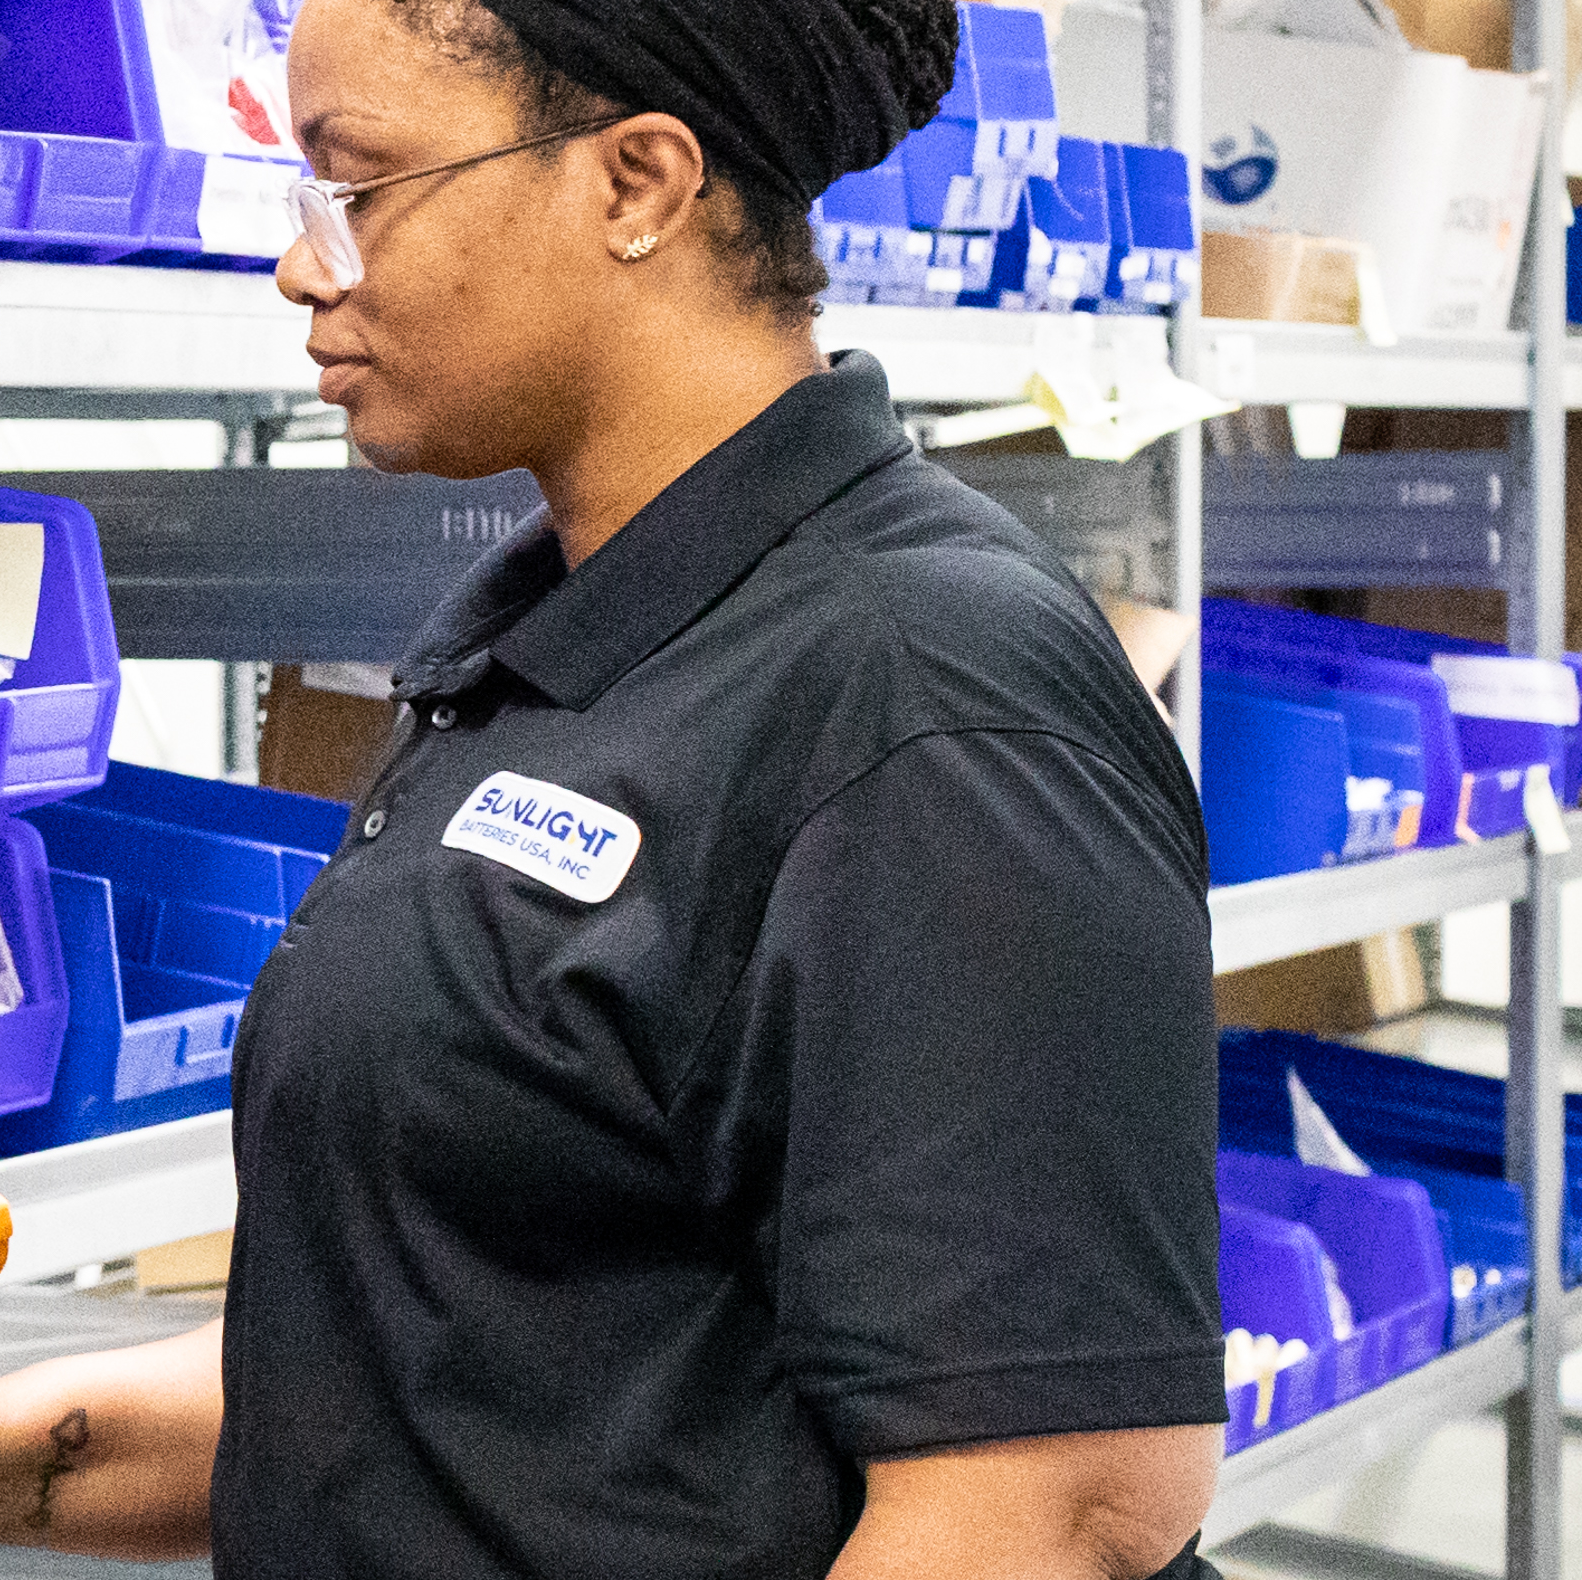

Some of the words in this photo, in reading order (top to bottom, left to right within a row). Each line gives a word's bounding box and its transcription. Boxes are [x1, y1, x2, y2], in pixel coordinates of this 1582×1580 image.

[459, 819, 519, 847] BATTERIES
[520, 837, 552, 866] USA,
[557, 856, 592, 880] INC
[474, 788, 618, 857] SUNLIGHT
